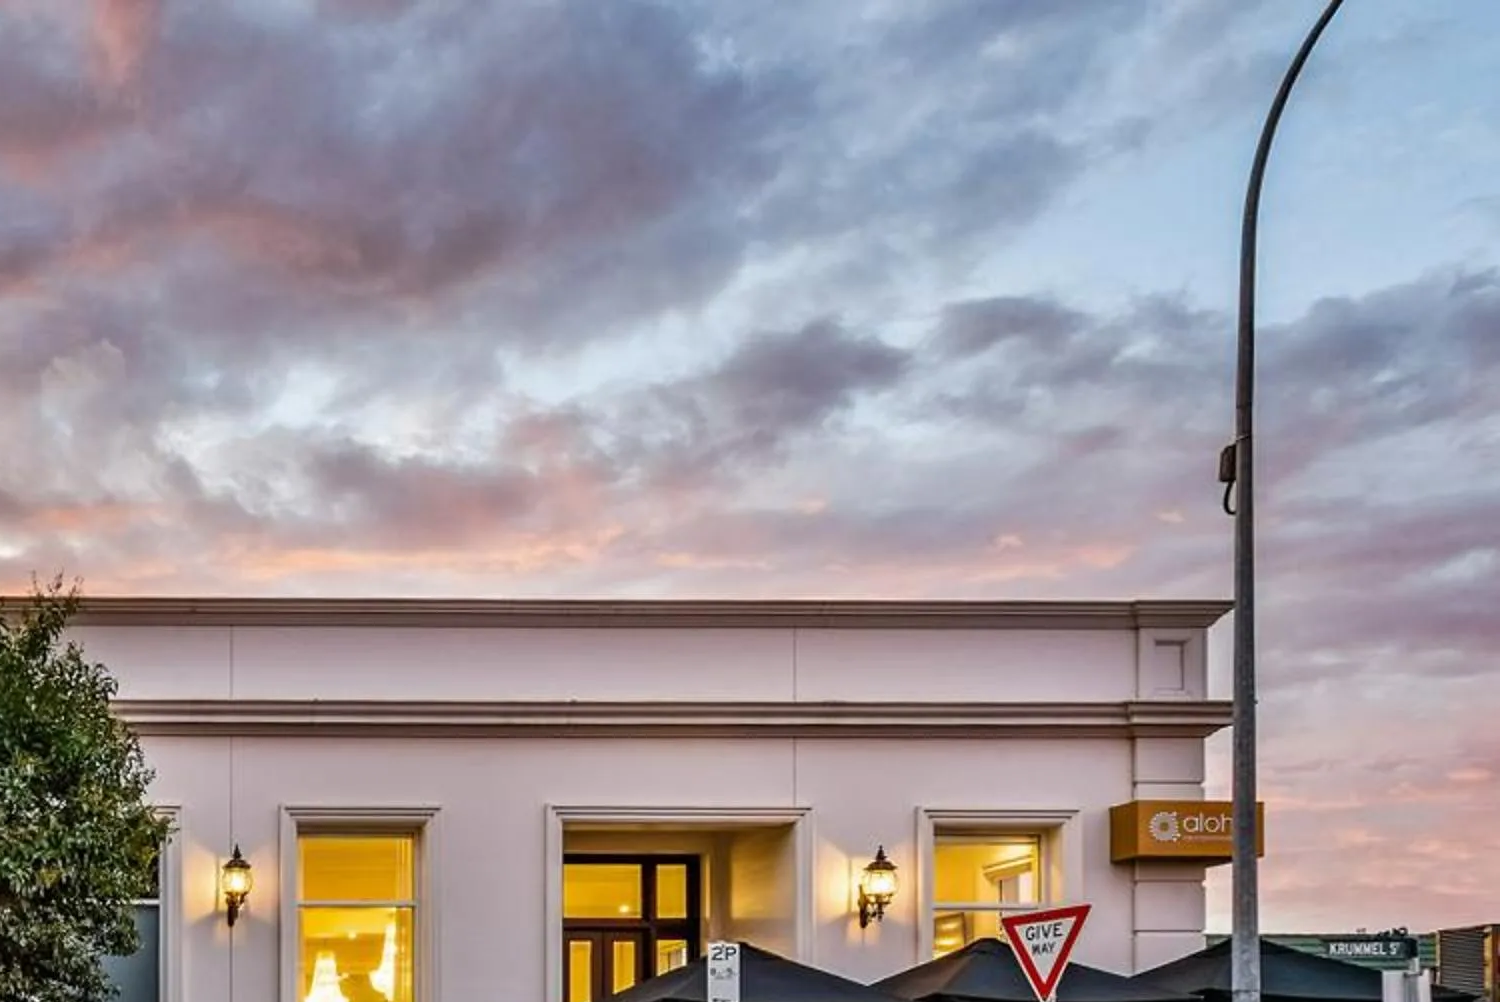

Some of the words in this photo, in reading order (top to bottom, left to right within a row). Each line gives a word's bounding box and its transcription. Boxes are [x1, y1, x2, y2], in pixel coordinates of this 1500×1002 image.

[1183, 812, 1233, 833] aloh
[1025, 922, 1063, 941] GIVE
[711, 946, 737, 961] 2P
[1031, 942, 1056, 955] WAY
